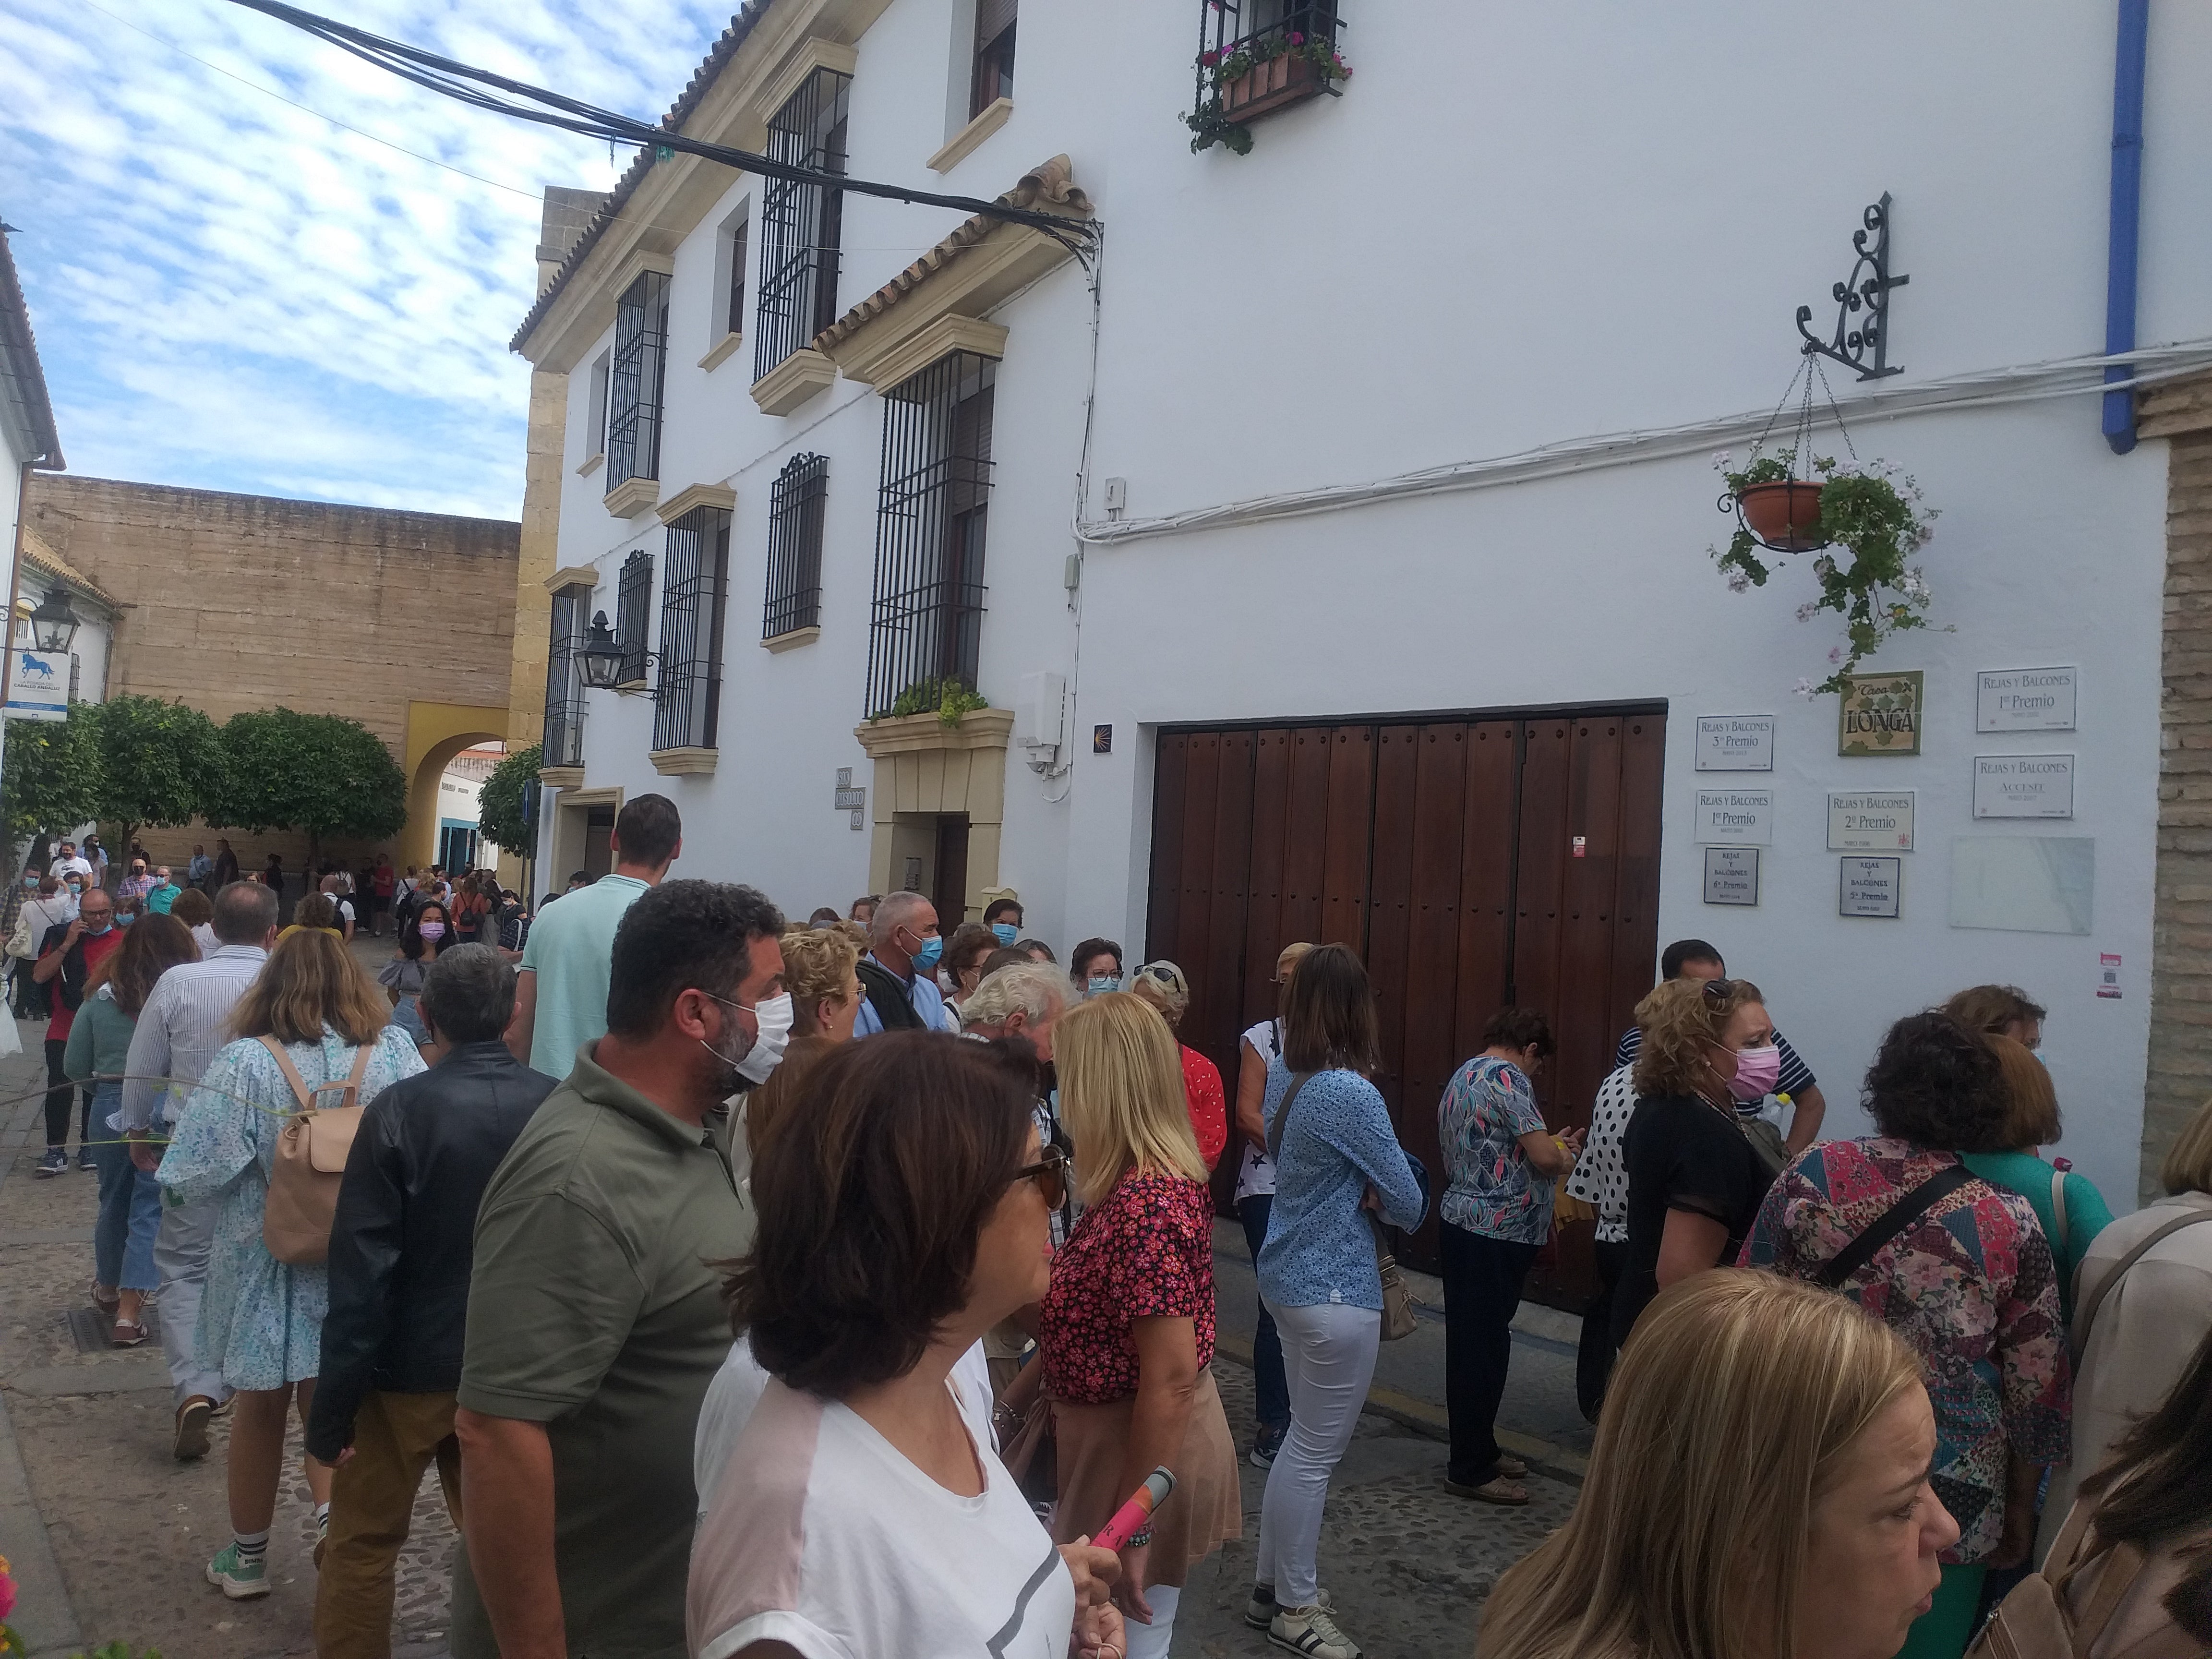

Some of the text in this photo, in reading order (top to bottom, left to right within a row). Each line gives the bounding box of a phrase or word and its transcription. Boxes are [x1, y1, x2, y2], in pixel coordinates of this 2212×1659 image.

[1984, 675, 2070, 689] REJAS Y BALCONES
[1858, 684, 1889, 696] Casa
[2013, 693, 2055, 708] Premio
[1702, 721, 1769, 732] REJAS Y BALCONES
[1846, 708, 1914, 733] LONGA
[1726, 735, 1758, 746] Premio
[1981, 761, 2068, 774] REJAS Y BALCONES
[837, 792, 863, 805] BASILIO
[1701, 795, 1768, 806] REJAS Y BALCONES
[1834, 798, 1909, 809] REJAS Y BALCONES
[1723, 812, 1755, 824] Premio
[1859, 815, 1896, 829] Premio
[1723, 880, 1748, 889] Premio
[1861, 891, 1888, 900] Premio
